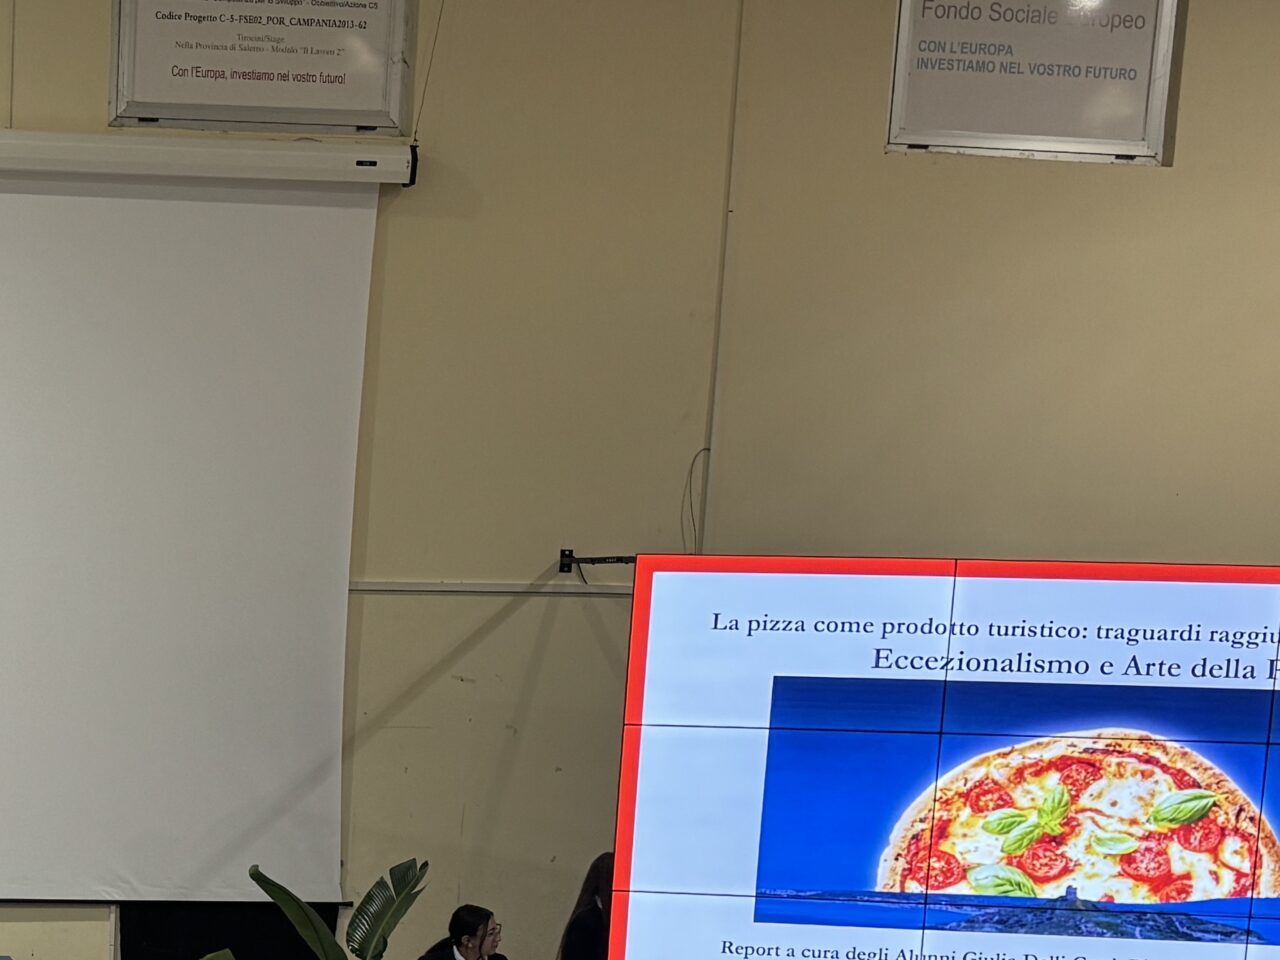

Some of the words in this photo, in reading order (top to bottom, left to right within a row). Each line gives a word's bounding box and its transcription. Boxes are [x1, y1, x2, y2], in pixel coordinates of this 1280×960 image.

[155, 11, 182, 21] Codice
[184, 12, 218, 24] Progetto
[921, 0, 982, 20] Fondo
[989, 2, 1058, 25] Sociale
[918, 40, 946, 53] CON
[949, 41, 1014, 56] L'EUROPA
[171, 65, 189, 78] Con
[230, 68, 275, 82] investiamo
[277, 70, 290, 82] nel
[291, 72, 318, 83] vostro
[319, 71, 346, 85] futuro!
[916, 57, 996, 73] INVESTIAMO
[999, 61, 1024, 75] NEL
[1028, 62, 1081, 78] VOSTRO
[1085, 66, 1137, 81] FUTURO
[711, 613, 739, 631] La
[747, 614, 806, 637] pizza
[813, 619, 874, 634] come
[880, 617, 980, 639] prodotto
[988, 620, 1088, 639] turistico:
[1096, 623, 1202, 646] traguardi
[871, 648, 1090, 677] Eccezionalismo
[1100, 660, 1114, 676] e
[1121, 654, 1182, 678] Arte
[1191, 657, 1257, 680] della
[721, 940, 781, 960] Report
[786, 947, 796, 958] a
[801, 946, 840, 960] cura
